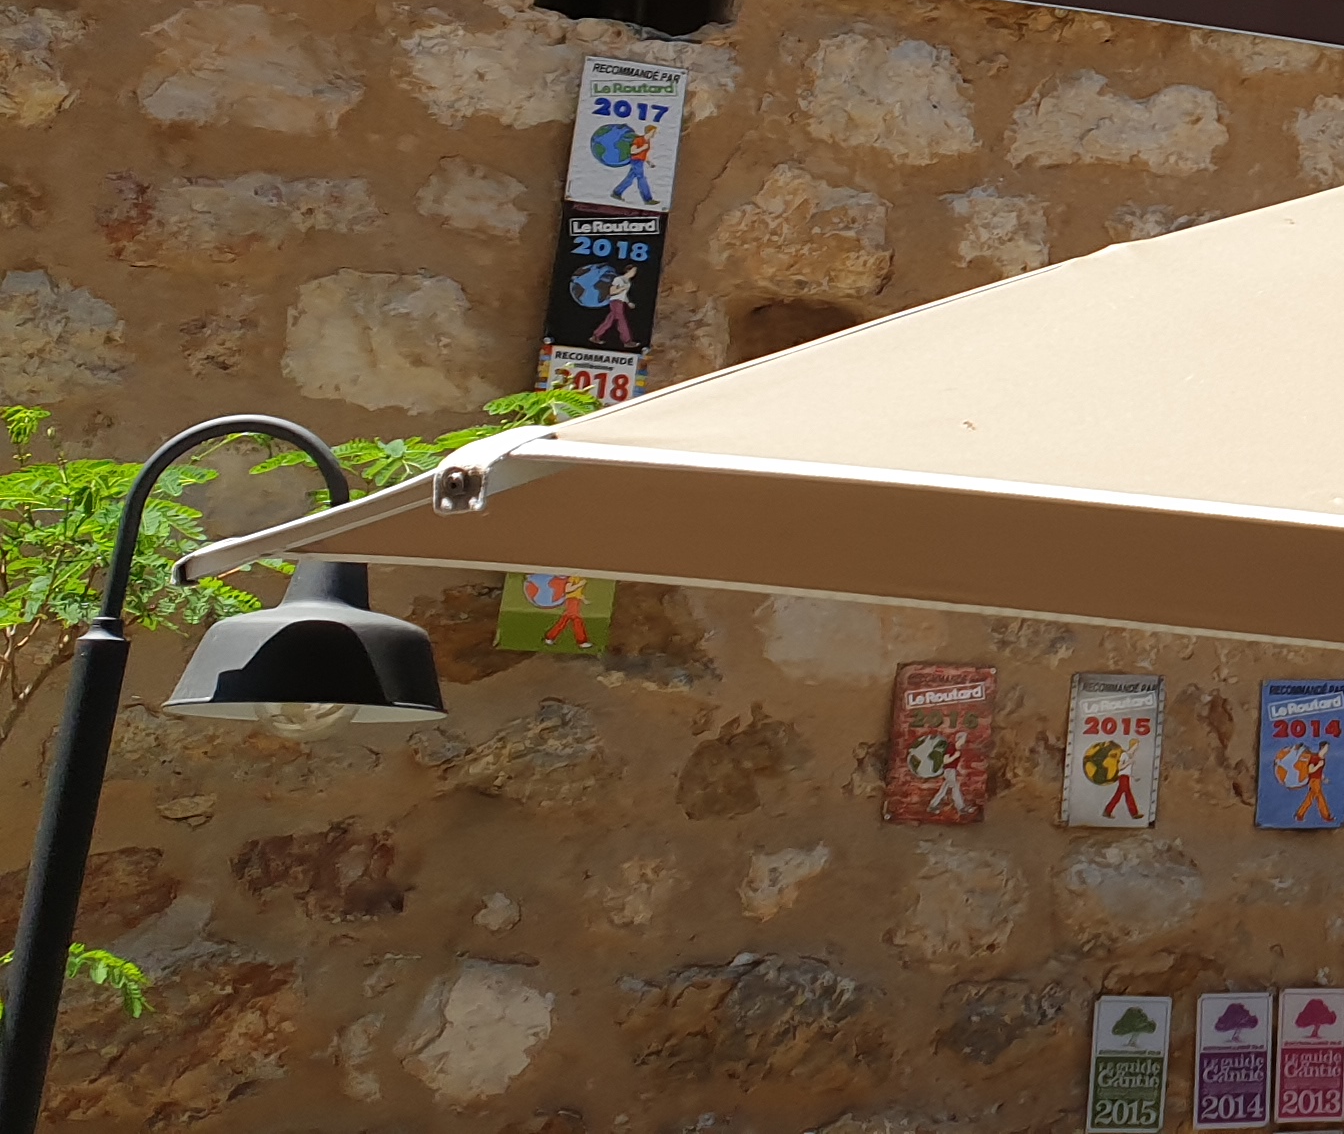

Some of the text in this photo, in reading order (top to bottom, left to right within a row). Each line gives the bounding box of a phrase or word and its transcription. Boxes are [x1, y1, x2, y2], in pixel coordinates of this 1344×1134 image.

[592, 63, 681, 84] RECOMMANDÉ PAR
[593, 82, 674, 94] Le Routard
[591, 97, 669, 123] 2017
[572, 219, 656, 233] Le Routard
[570, 236, 650, 262] 2018
[555, 350, 634, 366] RECOMMANDÉ
[908, 686, 983, 706] Le Routard
[1271, 695, 1342, 718] Le Routard
[909, 708, 978, 729] 2016
[1082, 716, 1151, 736] 2015
[1272, 719, 1342, 739] 2014
[1094, 1099, 1158, 1125] 2015
[1200, 1094, 1264, 1120] 2014
[1281, 1089, 1341, 1114] 2013
